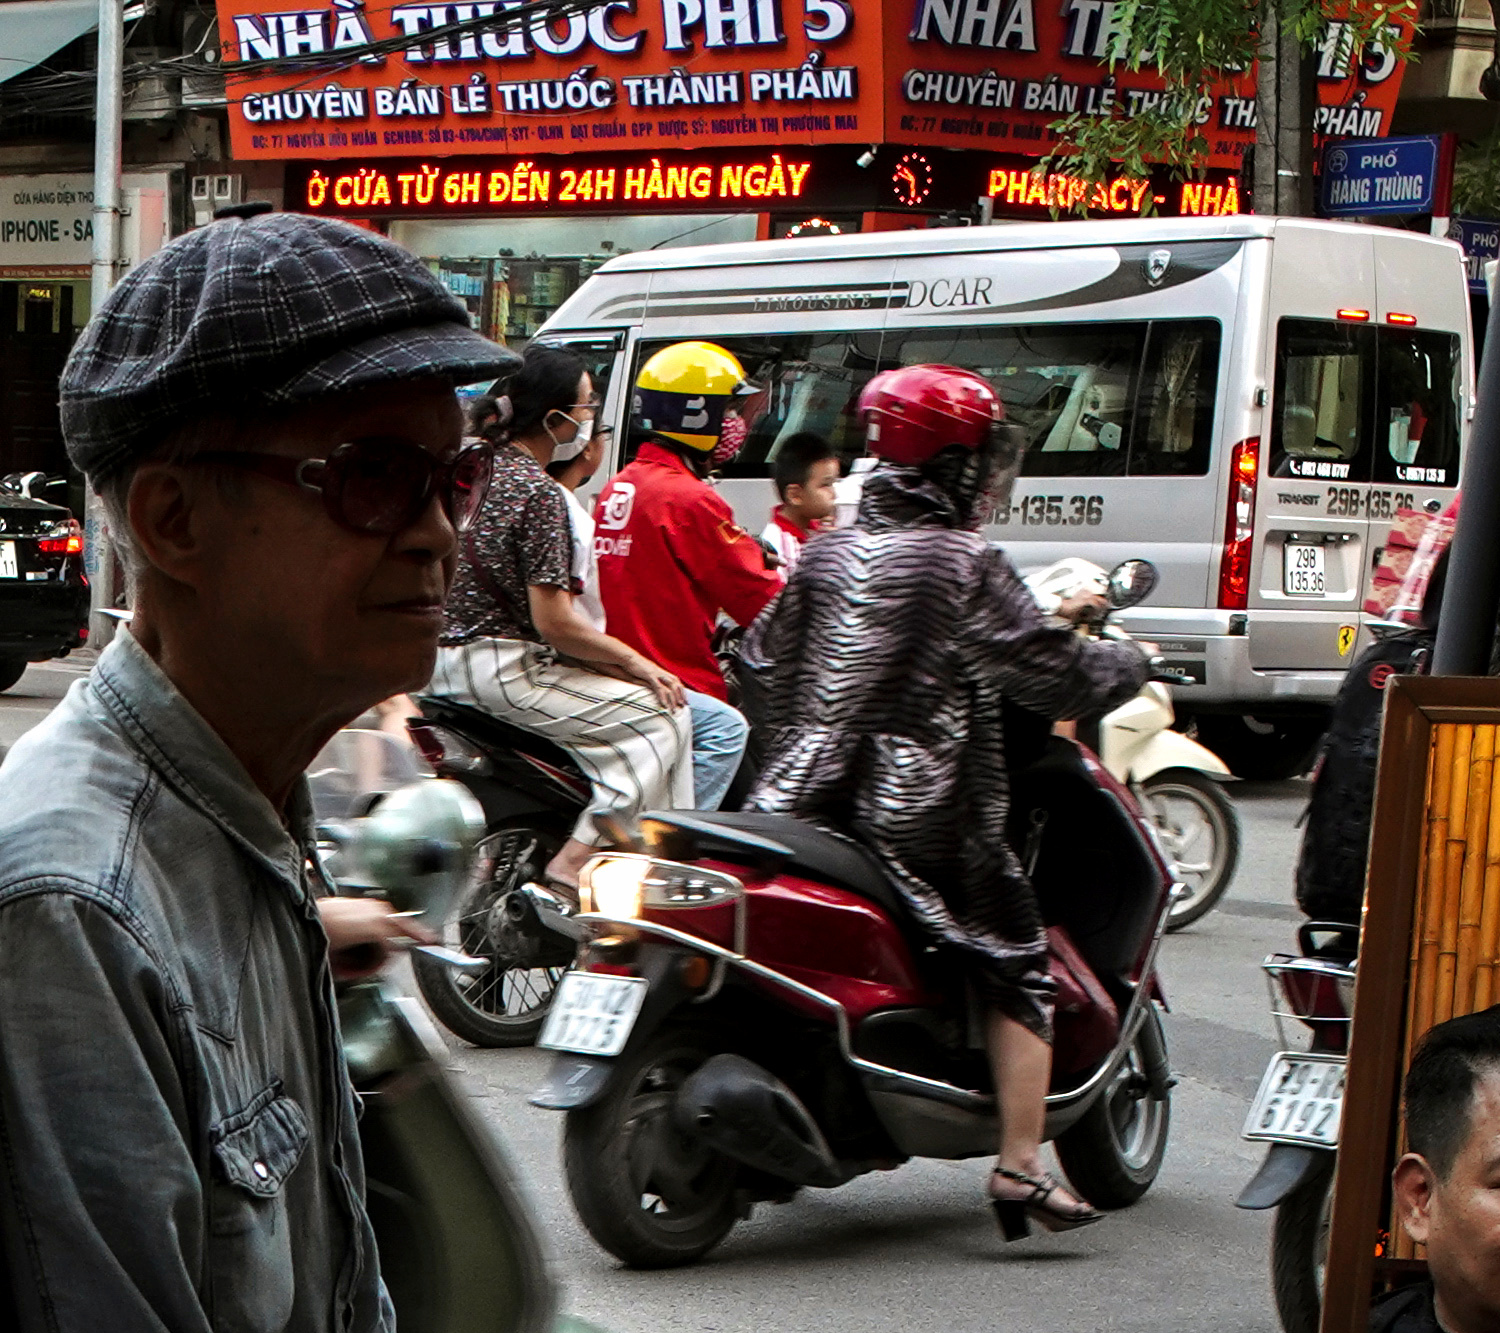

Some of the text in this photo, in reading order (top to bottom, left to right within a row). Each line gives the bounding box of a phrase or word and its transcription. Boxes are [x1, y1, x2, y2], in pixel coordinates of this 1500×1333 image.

[803, 0, 850, 42] 5
[243, 52, 853, 121] CHUYÊN BÁN LẺ THUỐC THÀNH PHẨM
[906, 69, 1016, 108] CHUYÊN
[1024, 74, 1080, 113] BÁN
[1127, 82, 1213, 124] THC
[1360, 147, 1399, 169] PHỐ
[334, 168, 391, 205] CỬA
[398, 164, 438, 204] TỪ
[443, 170, 482, 203] 6H
[488, 162, 551, 202] ĐẾN
[559, 167, 614, 202] 24H
[623, 157, 711, 200] HÀNG
[719, 154, 811, 198] NGÀY
[988, 169, 1240, 216] PHARMACY NHÀ
[1330, 171, 1423, 205] HÀNG THÙNG
[2, 218, 94, 243] IPHONE SA
[752, 293, 872, 313] LIMOUSINE
[903, 276, 993, 309] DCAR
[1296, 548, 1317, 569] 29B
[1289, 571, 1324, 592] 135.36
